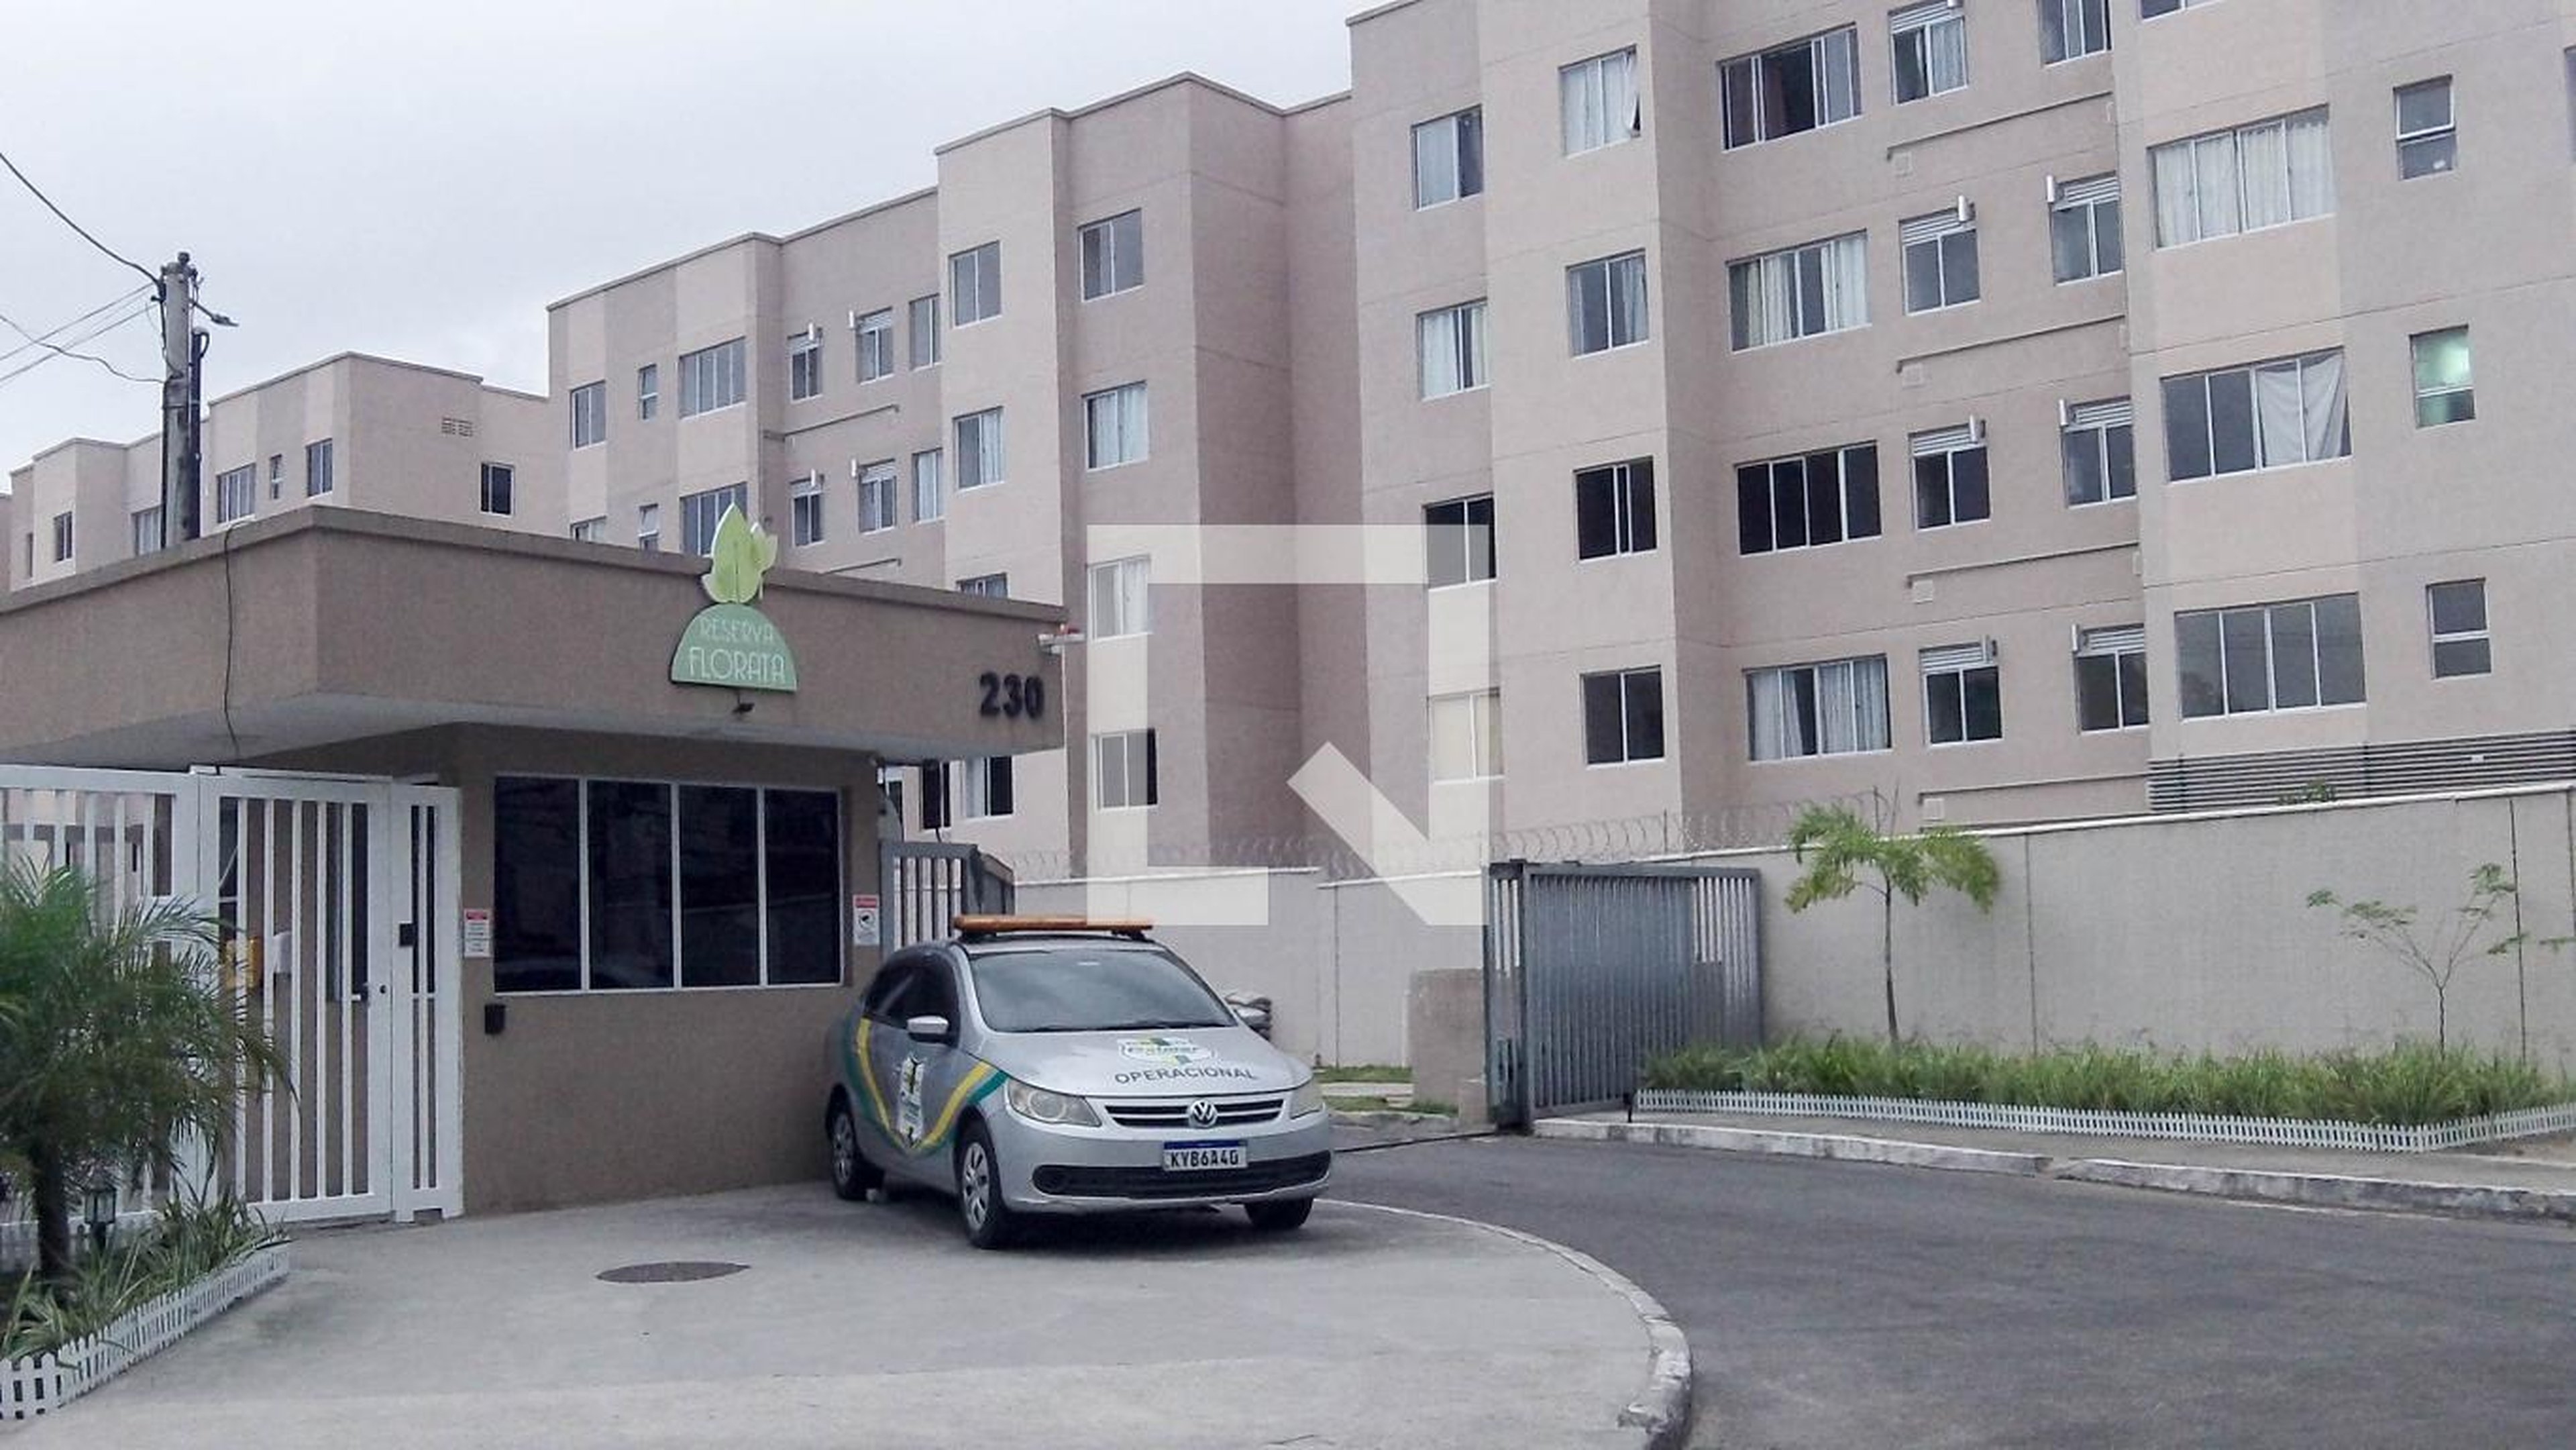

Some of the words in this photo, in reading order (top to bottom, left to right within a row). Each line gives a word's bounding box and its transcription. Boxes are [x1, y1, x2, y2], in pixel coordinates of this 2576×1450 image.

[699, 617, 774, 643] RESERVA
[689, 647, 785, 682] FLORATA
[979, 671, 1044, 718] 230
[1114, 1068, 1258, 1084] OPERACIONAL
